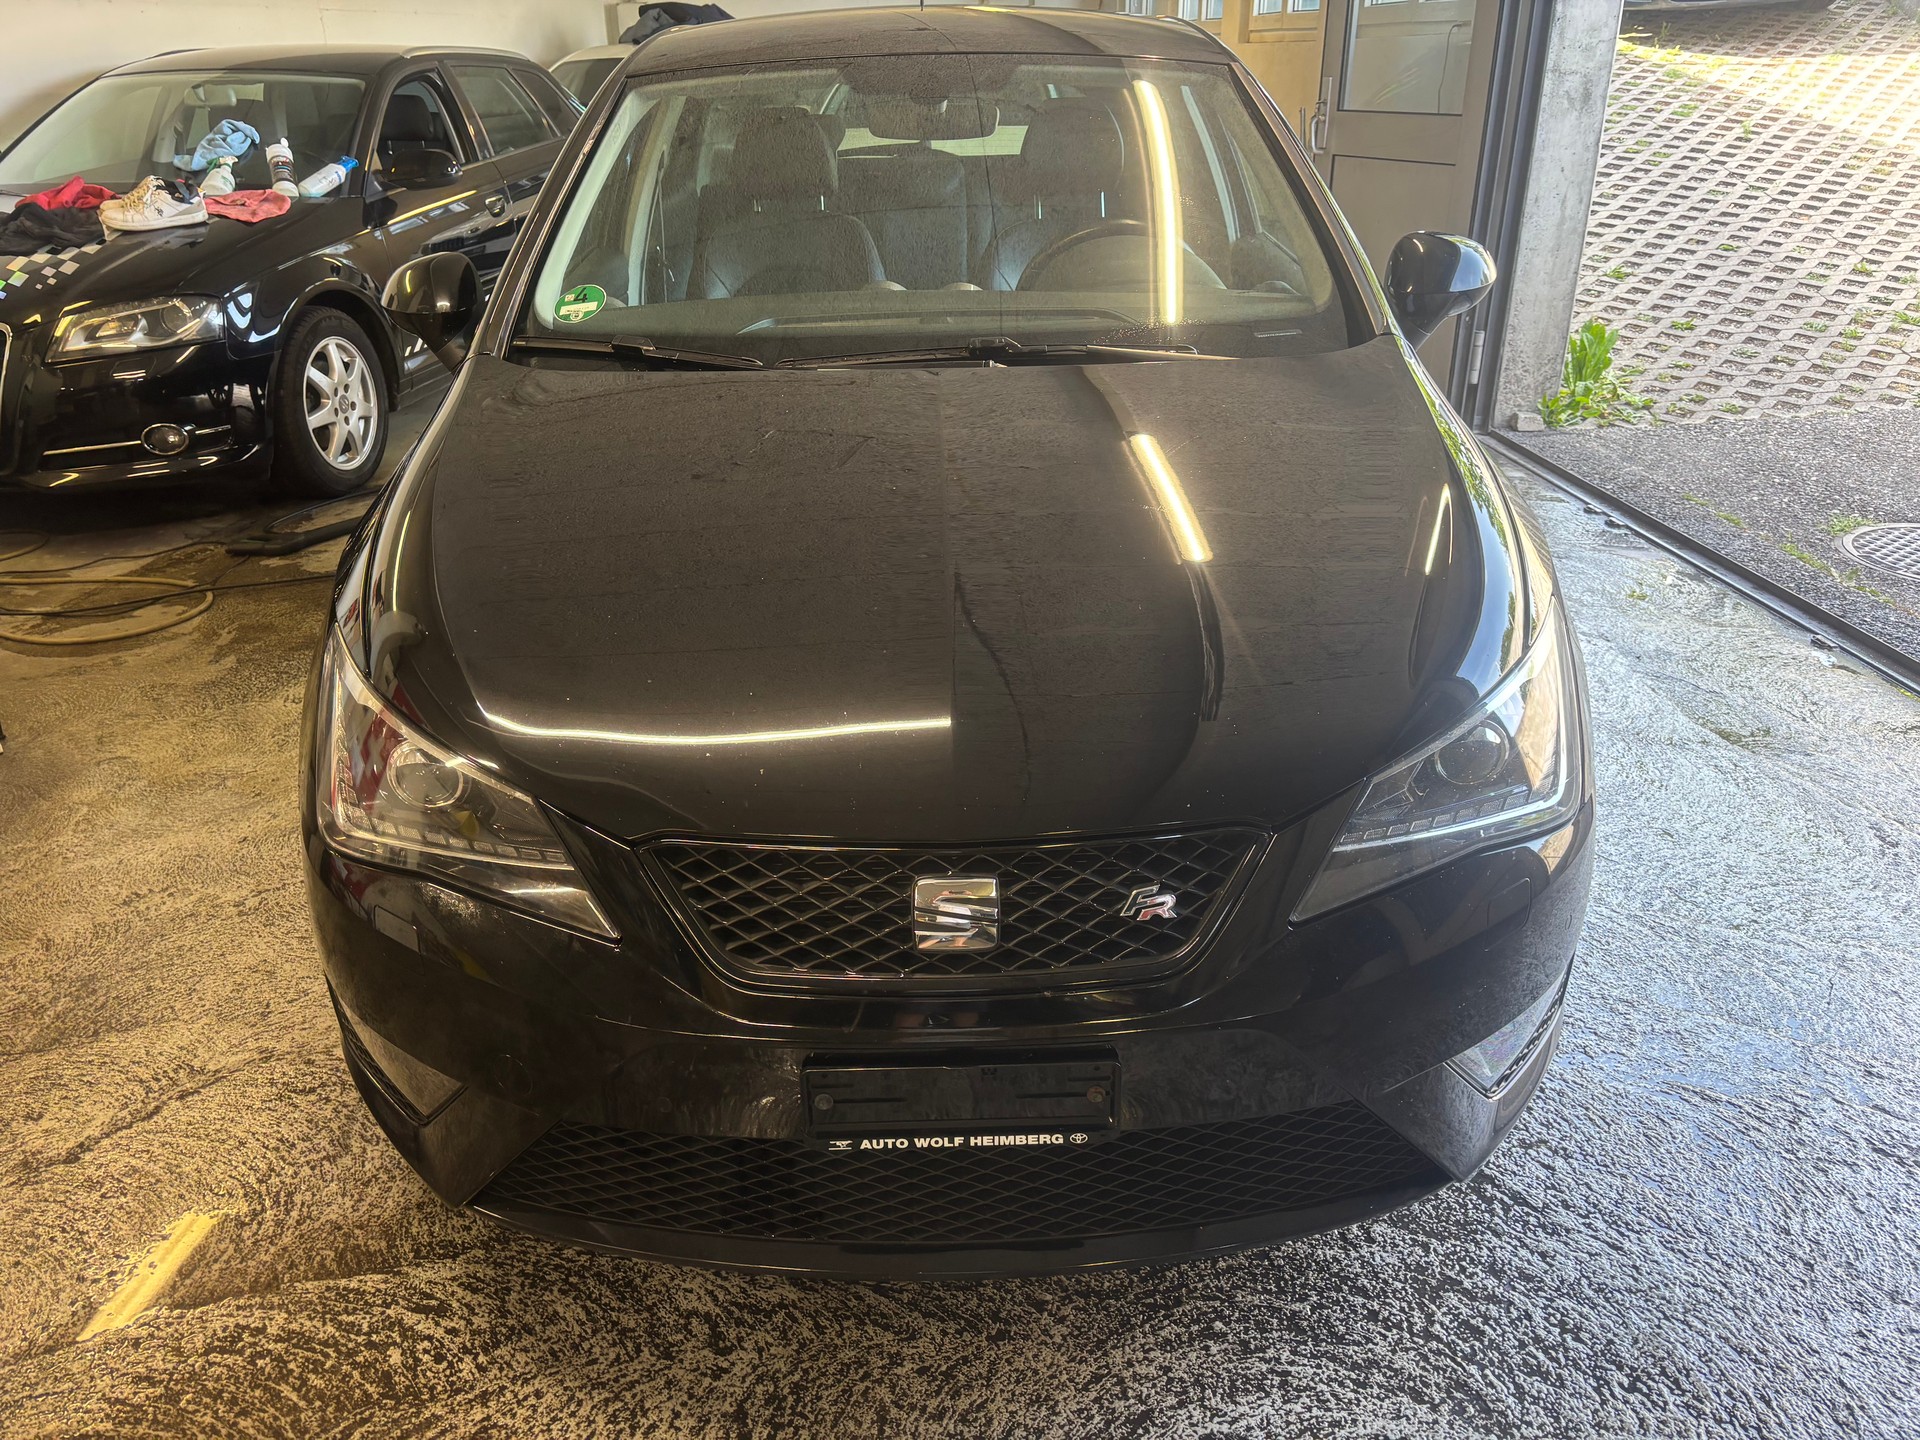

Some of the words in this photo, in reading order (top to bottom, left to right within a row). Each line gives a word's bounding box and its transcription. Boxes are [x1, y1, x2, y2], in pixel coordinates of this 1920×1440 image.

[573, 287, 588, 303] 4
[1119, 884, 1178, 921] FR
[859, 1137, 909, 1150] AUTO
[913, 1136, 965, 1148] WOLF
[969, 1133, 1065, 1147] HEIMBERG
